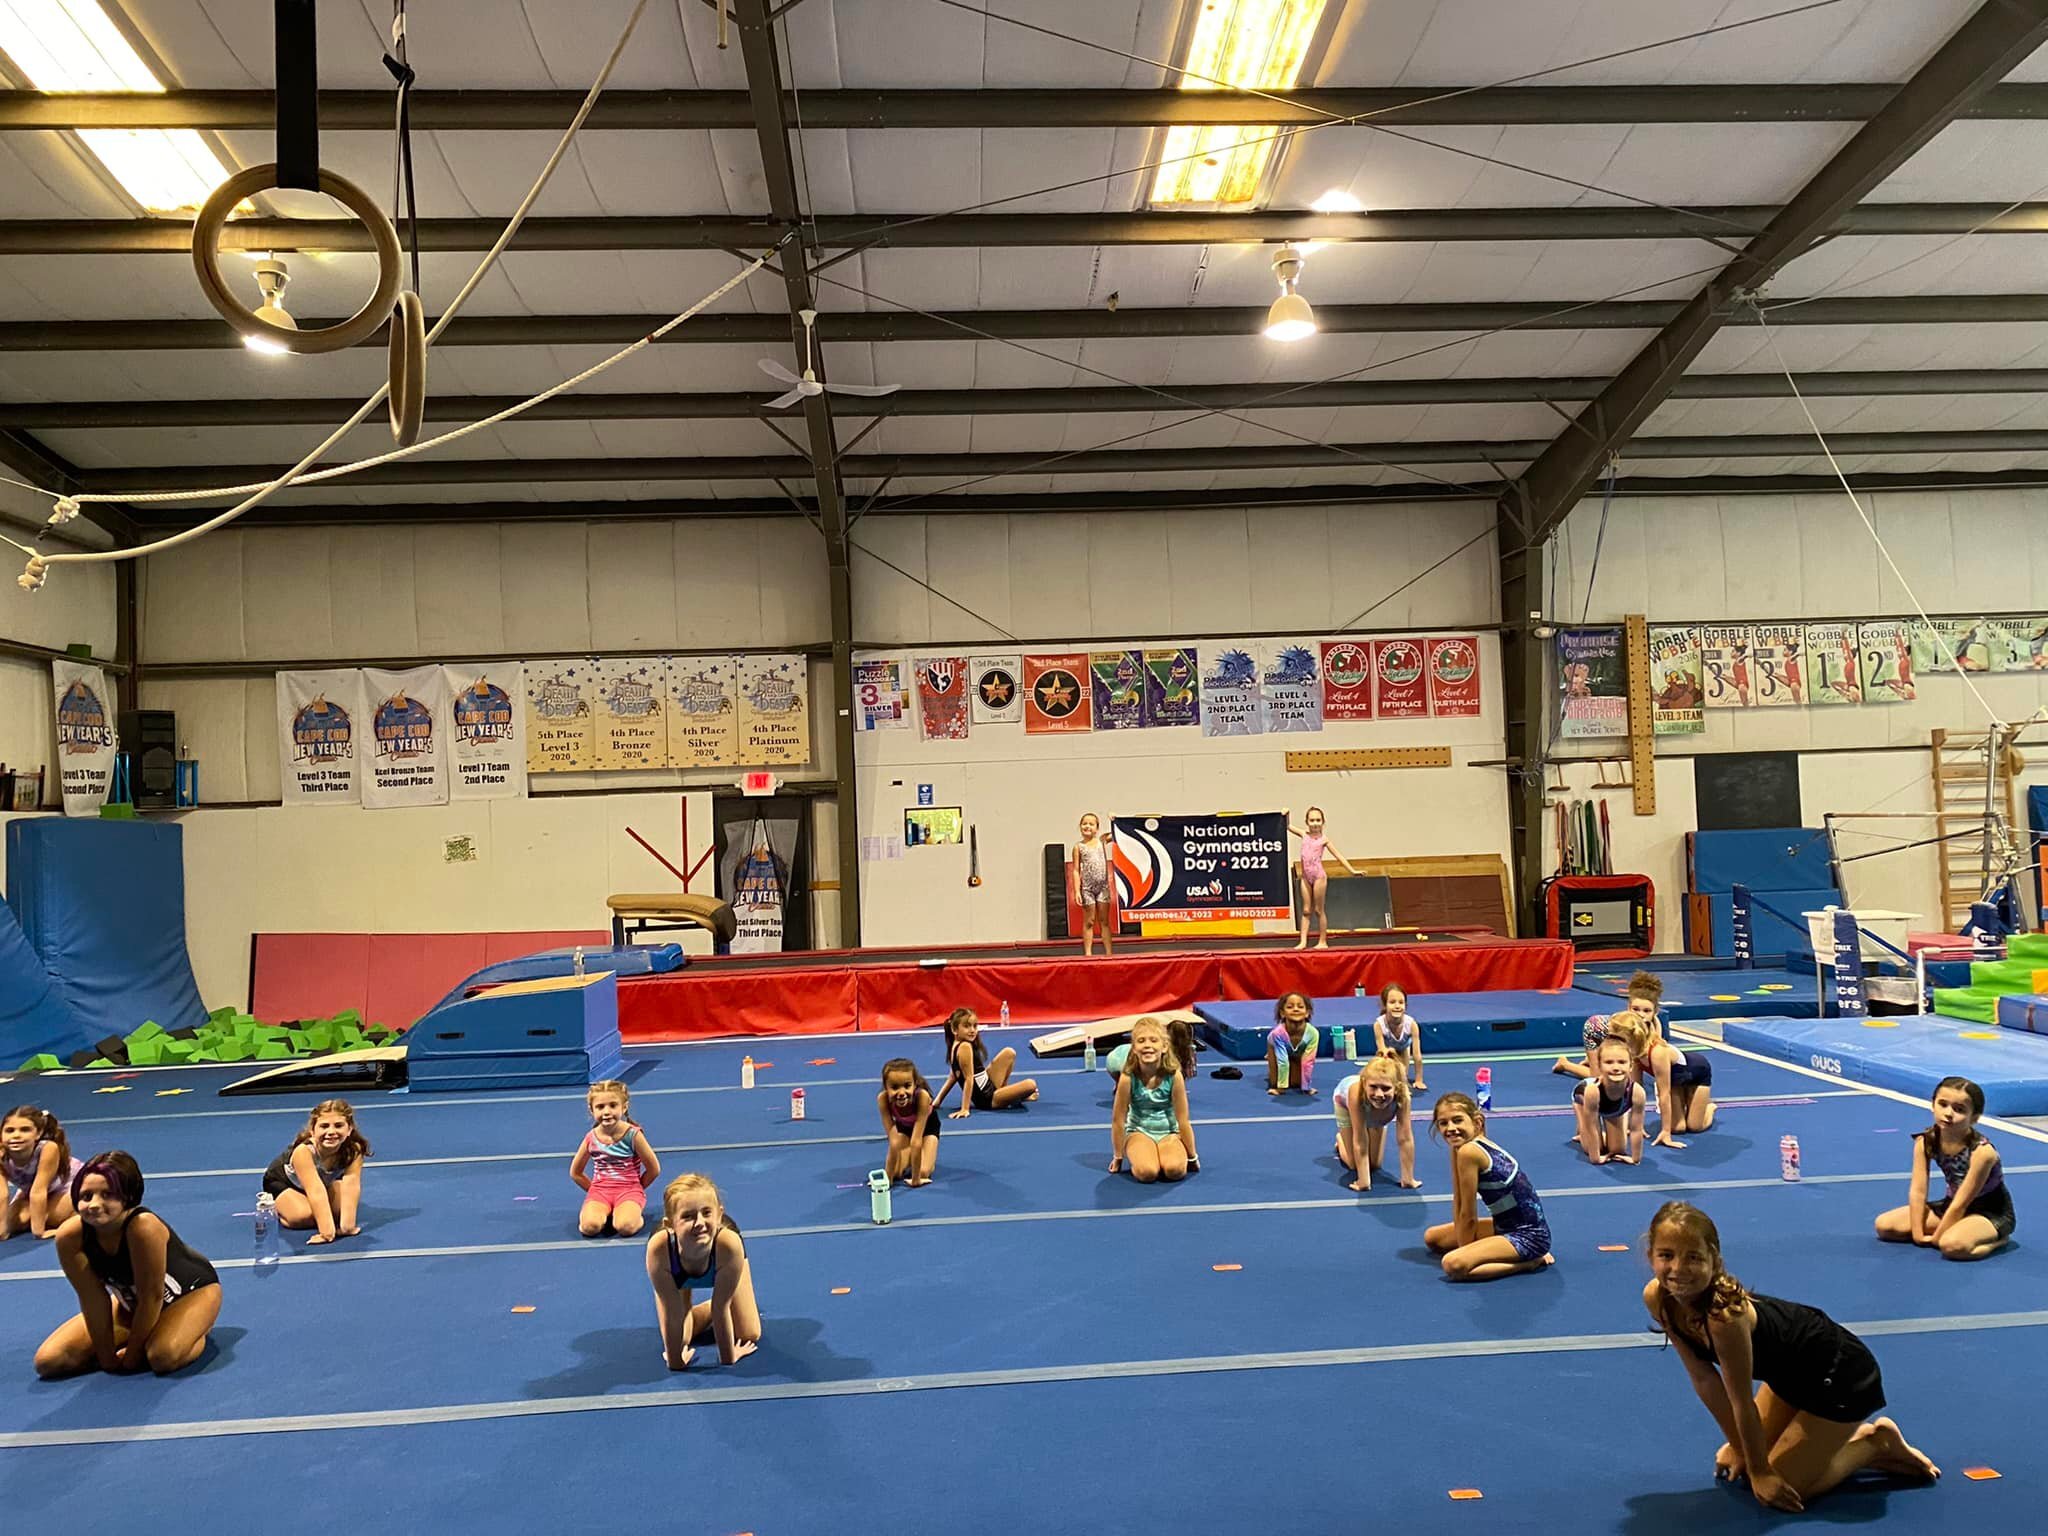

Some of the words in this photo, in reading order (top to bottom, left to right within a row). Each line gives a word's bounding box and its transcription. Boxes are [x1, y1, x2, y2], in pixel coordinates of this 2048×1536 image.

[1704, 629, 1750, 639] GOBBLE
[1756, 628, 1802, 638] GOBBLE
[1808, 631, 1855, 640] GOBBE
[1861, 629, 1908, 640] GOBBE
[1649, 629, 1695, 650] GOBBLE
[858, 670, 890, 678] Puzzle
[1214, 695, 1238, 703] LEVEL
[1243, 694, 1248, 702] 3
[864, 704, 892, 712] SILVER
[1208, 706, 1226, 714] 2ND
[1229, 704, 1256, 712] PLACE
[1268, 702, 1286, 710] 3RD
[1288, 700, 1315, 708] PLACE
[1400, 700, 1422, 708] PLACE
[1655, 711, 1674, 721] LEVEL
[1683, 710, 1703, 720] TEAM
[478, 723, 514, 740] YEAR'S
[610, 728, 626, 738] 4th
[628, 728, 656, 736] Place
[682, 727, 698, 736] 4th
[700, 726, 727, 735] Place
[752, 724, 768, 733] 4th
[770, 724, 797, 732] Place
[537, 731, 554, 740] 5th
[556, 730, 584, 738] Place
[612, 740, 652, 750] Bronze
[688, 738, 720, 748] Silver
[749, 736, 800, 746] Platinum
[540, 742, 570, 752] Level
[573, 742, 580, 752] 3
[764, 746, 784, 754] 2020
[550, 753, 571, 761] 2020
[622, 751, 642, 759] 2020
[459, 764, 480, 772] Level
[481, 764, 486, 772] 7
[487, 763, 510, 772] Team
[86, 770, 106, 780] Team
[297, 772, 319, 780] Level
[320, 771, 326, 780] 3
[328, 770, 351, 779] Team
[464, 776, 480, 784] 2nd
[482, 774, 505, 784] Place
[301, 783, 324, 792] Third
[325, 782, 349, 792] Place
[377, 778, 408, 788] Second
[410, 777, 434, 786] Place
[1183, 822, 1255, 838] National
[1183, 838, 1282, 857] Gymnastics
[1184, 857, 1218, 873] Day
[1230, 856, 1269, 870] 2022
[1186, 886, 1210, 896] USA
[1128, 912, 1178, 920] September
[750, 918, 770, 926] Silver
[770, 918, 781, 926] Tea
[739, 929, 760, 938] Third
[762, 928, 782, 938] Place
[1837, 986, 1858, 996] ce
[1819, 1056, 1842, 1074] UCS
